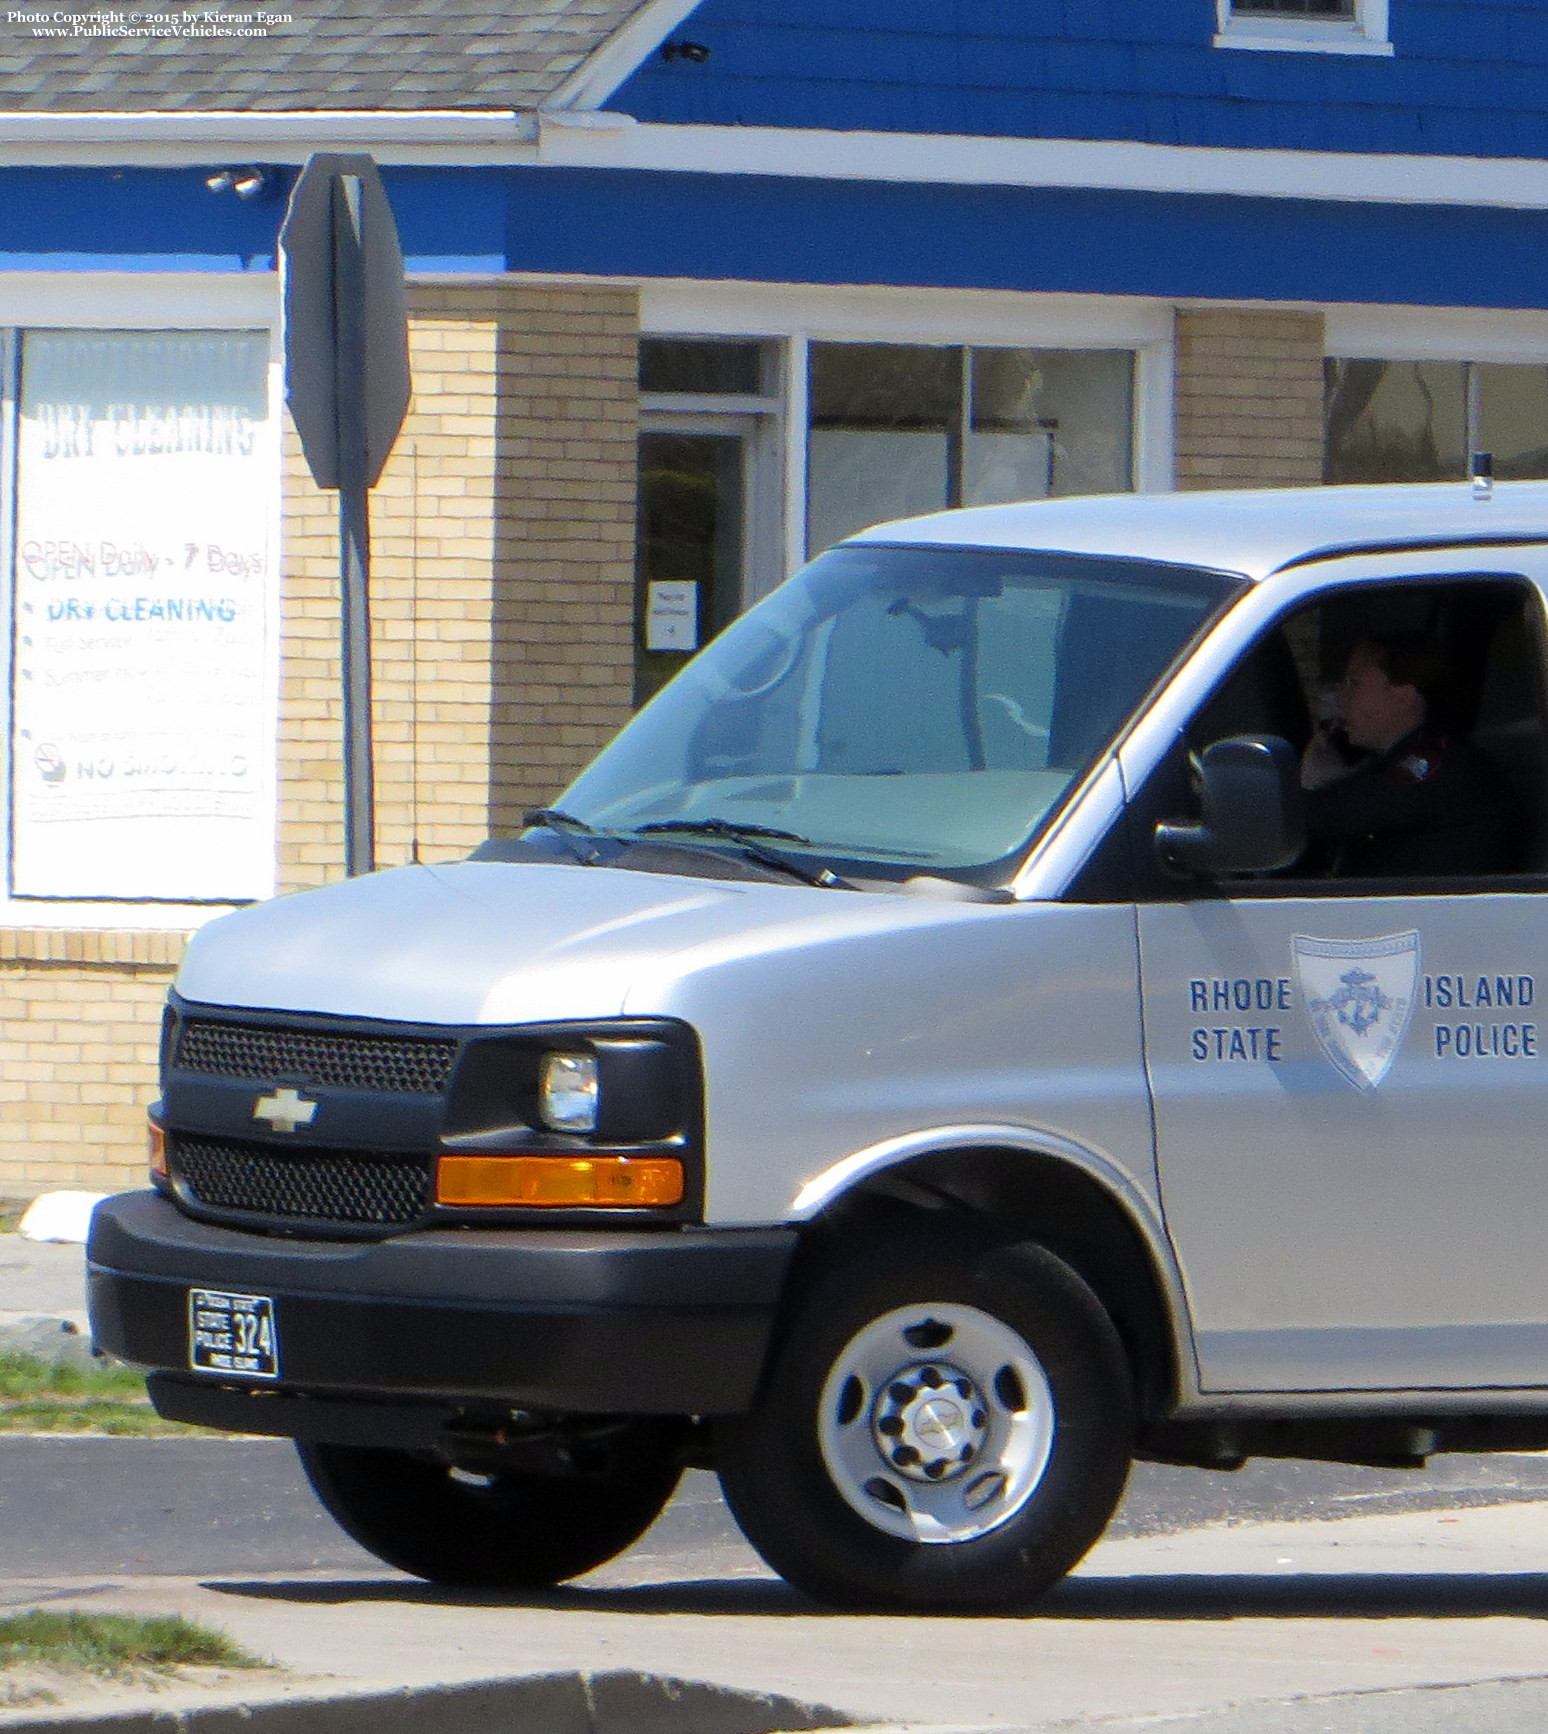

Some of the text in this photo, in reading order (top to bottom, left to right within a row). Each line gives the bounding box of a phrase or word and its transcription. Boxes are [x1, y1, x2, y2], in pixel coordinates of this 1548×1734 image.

[104, 597, 237, 622] CLEANING
[1190, 975, 1535, 1011] RHODE ISLAND
[1191, 1023, 1538, 1061] STATE POLICE
[233, 1312, 272, 1357] 324
